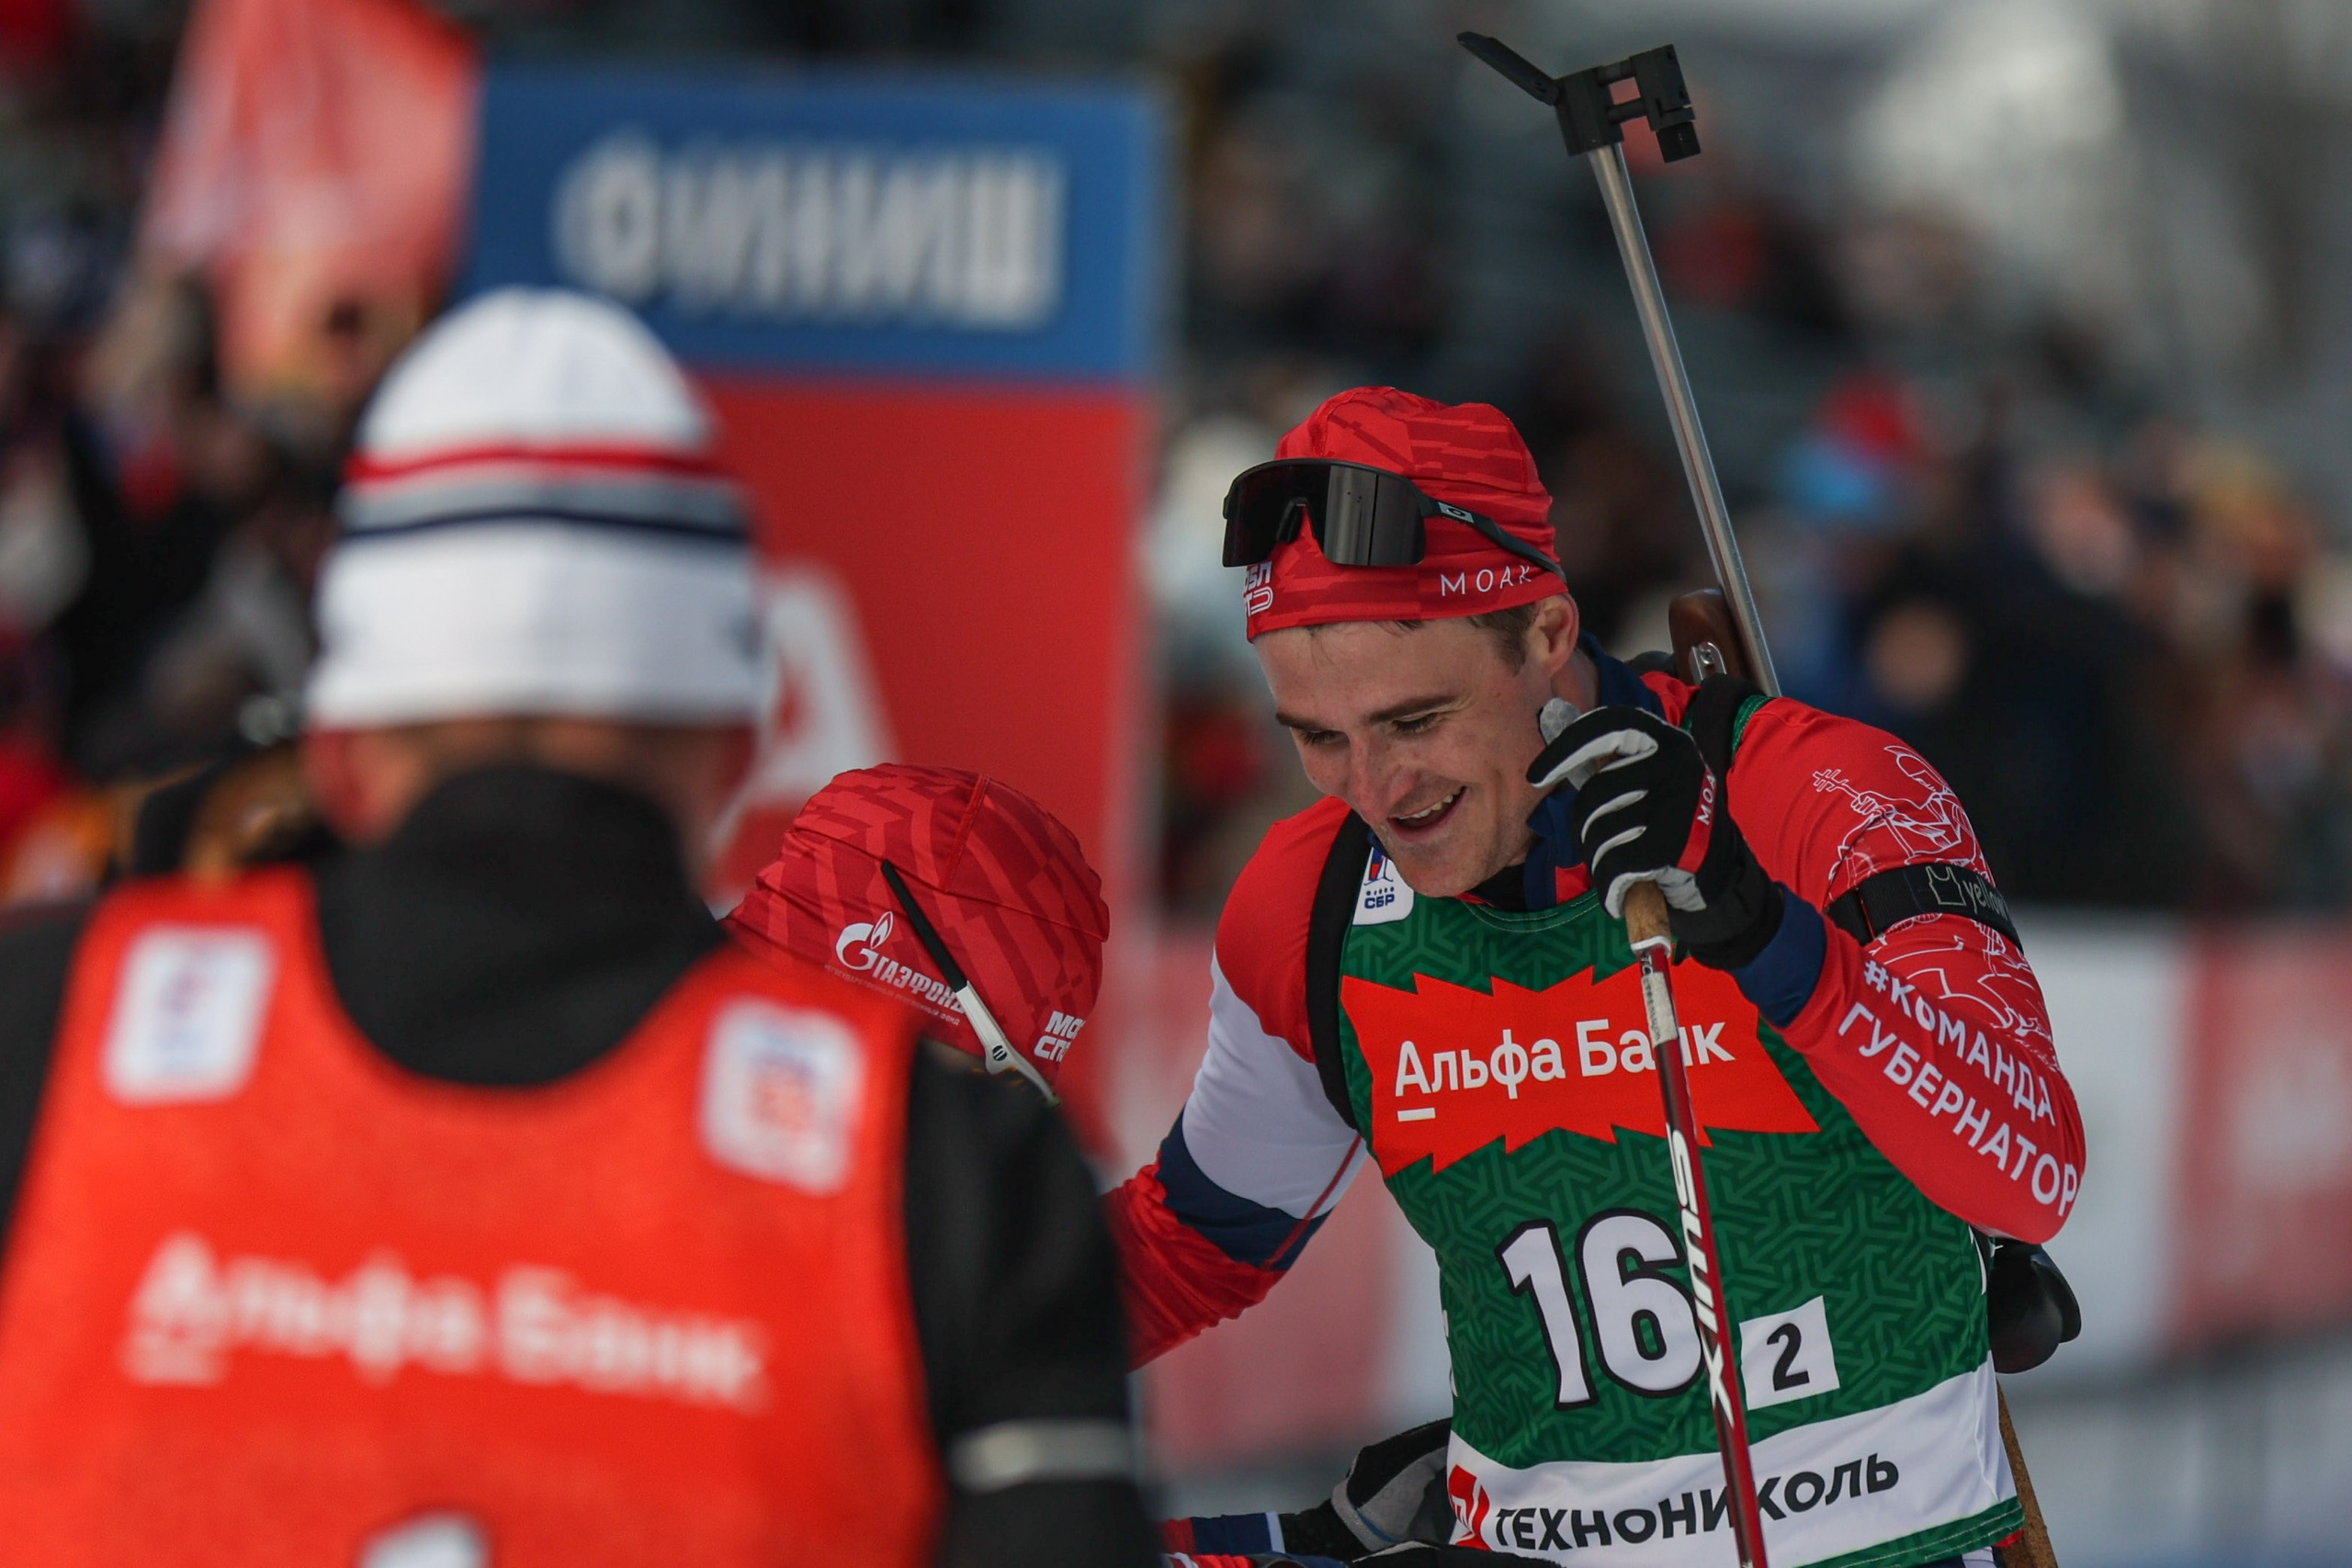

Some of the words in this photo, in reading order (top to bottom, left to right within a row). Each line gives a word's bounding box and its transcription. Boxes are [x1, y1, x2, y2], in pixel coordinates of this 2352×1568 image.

[555, 130, 1066, 327] ФИНИШ
[1364, 894, 1395, 909] СБР
[940, 1013, 961, 1026] ФОНД
[1395, 1029, 1566, 1100] Альфа
[1864, 959, 2056, 1126] #КОМАНДА
[1838, 1002, 2077, 1217] ГУБЕРНАТОР
[121, 1229, 487, 1385] Альфа
[494, 1264, 768, 1415] Банк
[1495, 1209, 1703, 1411] 16
[1666, 1122, 1735, 1428] SWIX
[1767, 1323, 1810, 1392] 2
